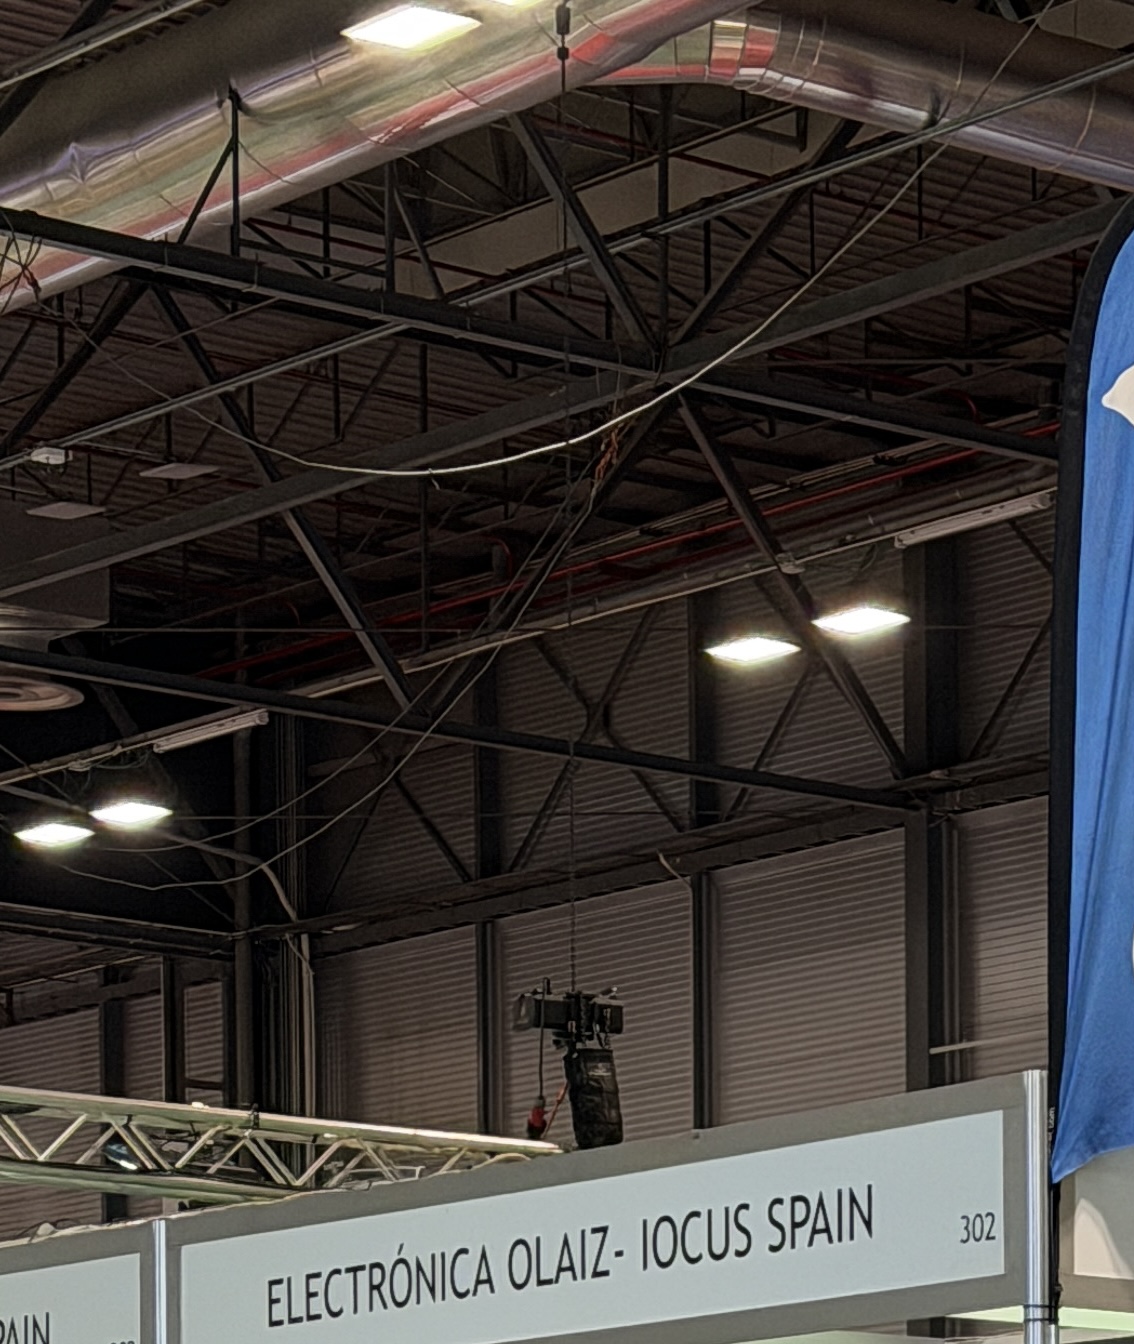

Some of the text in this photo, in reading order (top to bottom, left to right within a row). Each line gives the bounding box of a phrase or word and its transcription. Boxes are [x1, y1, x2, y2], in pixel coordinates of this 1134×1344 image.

[268, 1184, 873, 1327] ELECTRÓNICA OLAIZ- IOCUS SPAIN
[960, 1212, 996, 1244] 302
